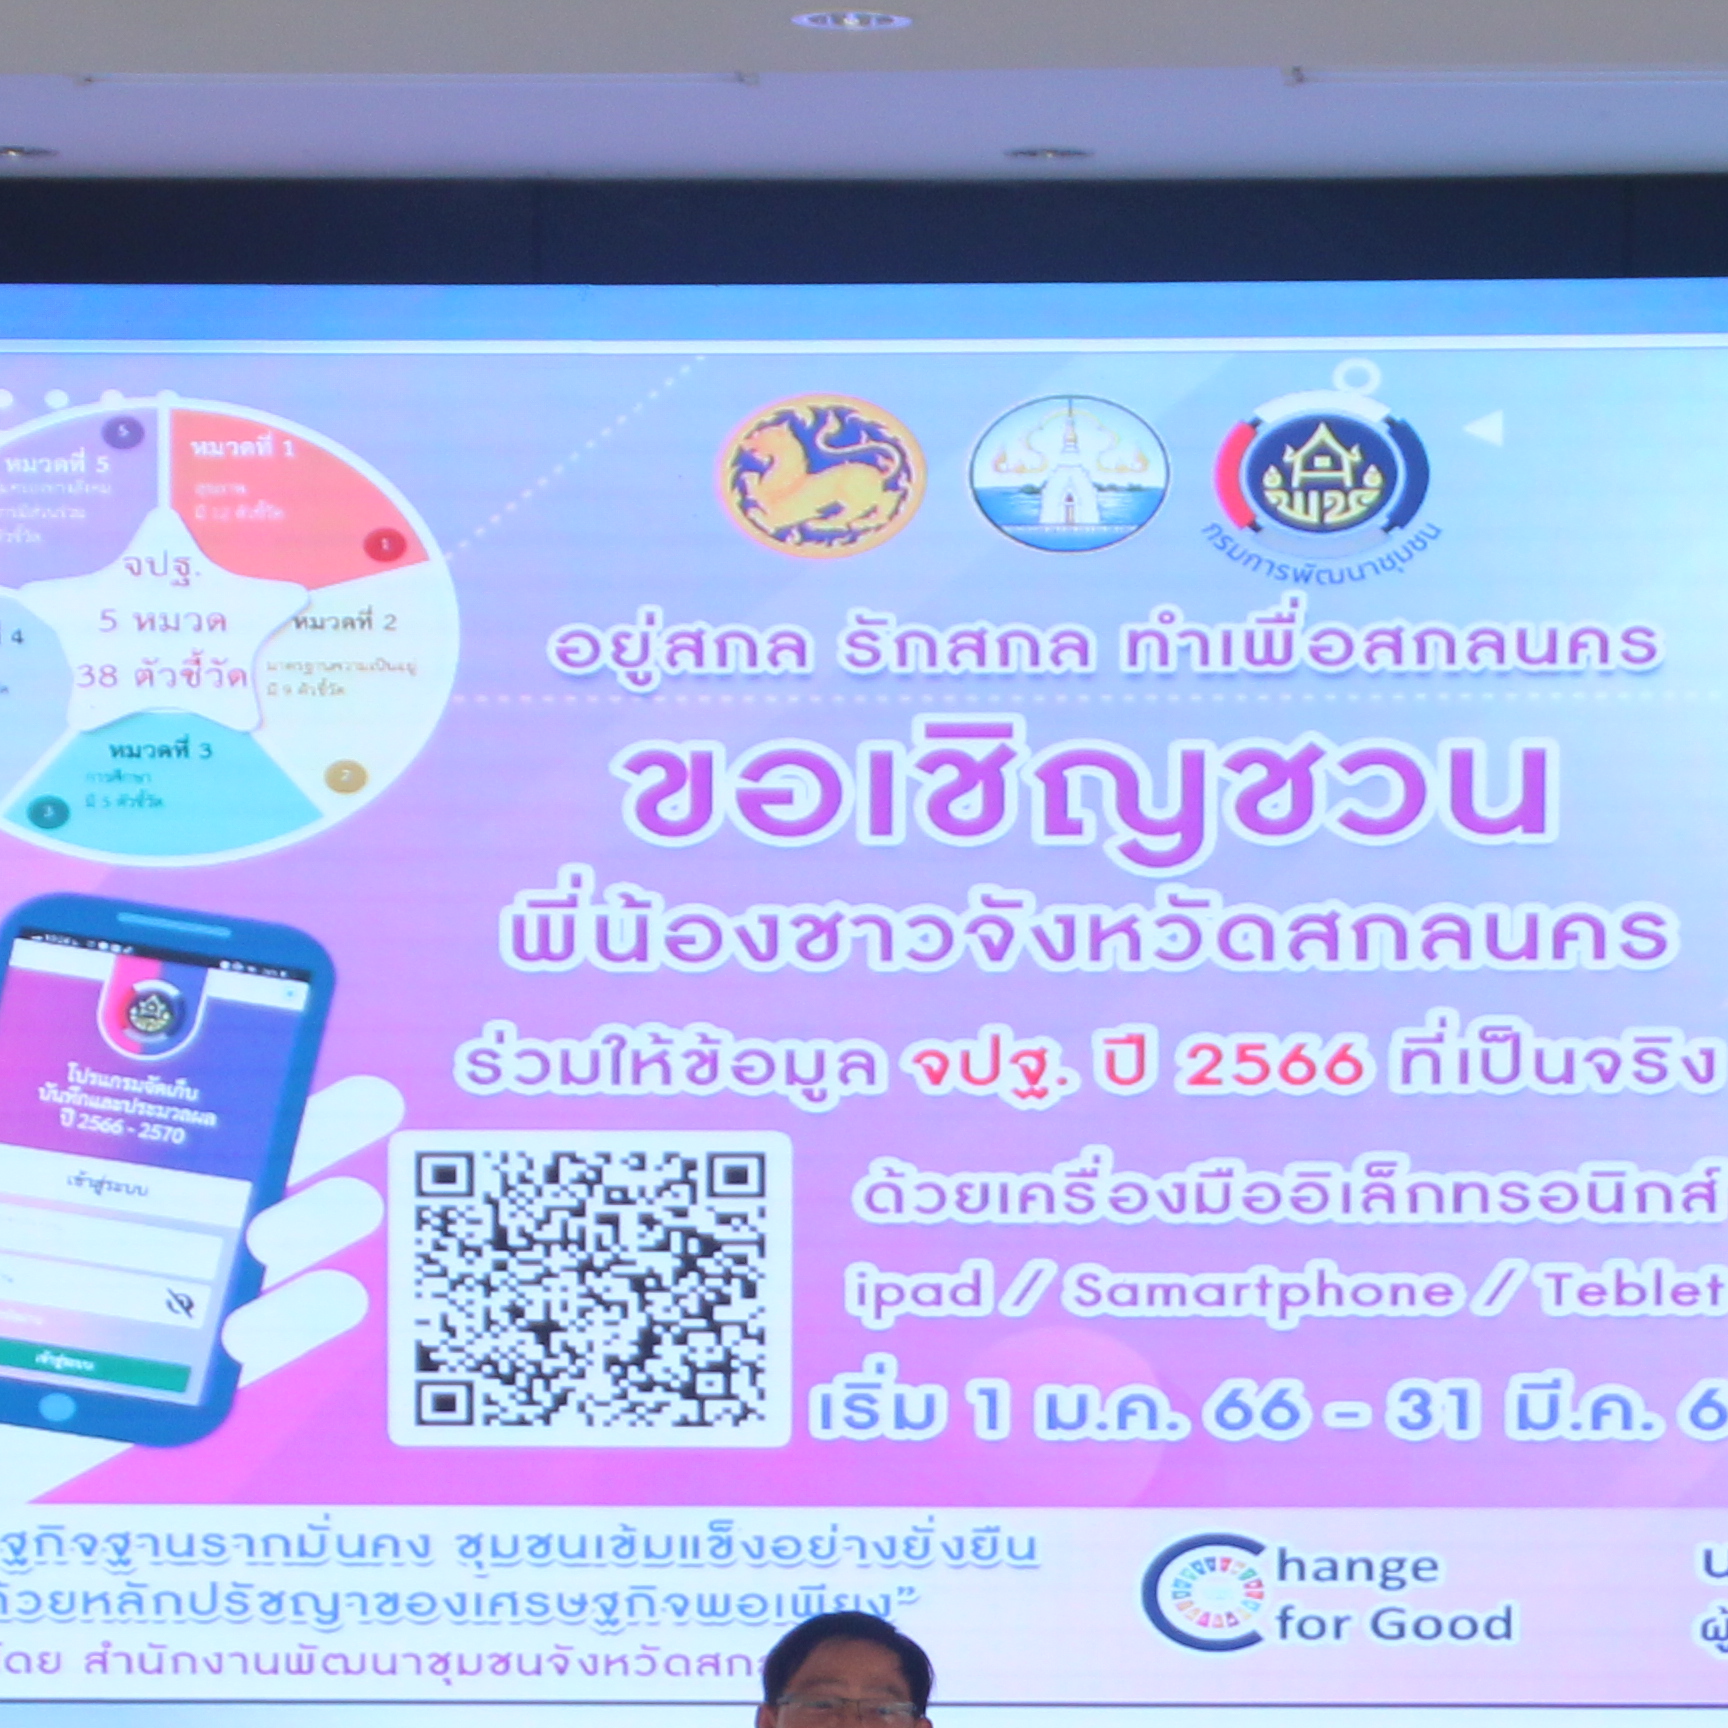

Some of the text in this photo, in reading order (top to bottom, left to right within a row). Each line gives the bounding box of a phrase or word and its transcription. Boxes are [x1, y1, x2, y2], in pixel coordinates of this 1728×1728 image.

[5, 446, 110, 474] หมวดที่ 5
[190, 430, 295, 457] หมวดที่ 1
[123, 549, 202, 587] จปฐ.
[11, 629, 25, 645] 4
[98, 607, 228, 633] 5 หมวด
[292, 604, 398, 631] หมวดที่ 2
[554, 597, 1658, 687] อยู่สกล รักสกล ทำเพื่อสกลนคร
[76, 648, 248, 688] 38 ตัวชี้วัด
[108, 733, 213, 759] หมวดที่ 3
[623, 722, 1547, 869] ขอเชิญชวน
[511, 873, 1668, 963] พี่น้องชาวจังหวัดสกลนคร
[467, 1016, 1717, 1103] ร่วมให้ข้อมูล จปฐ. ปี 2566 ที่เป็นจริง
[60, 1107, 76, 1127] ปี
[77, 1113, 124, 1135] 2566
[138, 1122, 186, 1144] 2570
[863, 1153, 1722, 1216] ด้วยเครื่องมืออิเล็กทรอนิกส์
[856, 1267, 1725, 1321] ipad / Samartphone / Teblet
[820, 1362, 935, 1431] เริ่ม
[977, 1388, 998, 1431] 1
[1047, 1392, 1180, 1431] ม.ค.
[1214, 1387, 1301, 1431] 66
[1397, 1387, 1469, 1431] 31
[1517, 1377, 1655, 1431] มี.ค.
[456, 1516, 1037, 1568] ชุมชนเข้มแข็งอย่างยั่งยืน
[1275, 1604, 1514, 1642] for Good
[84, 1640, 767, 1685] สำนักงานพัฒนาชุมชนจังหวัดสก
